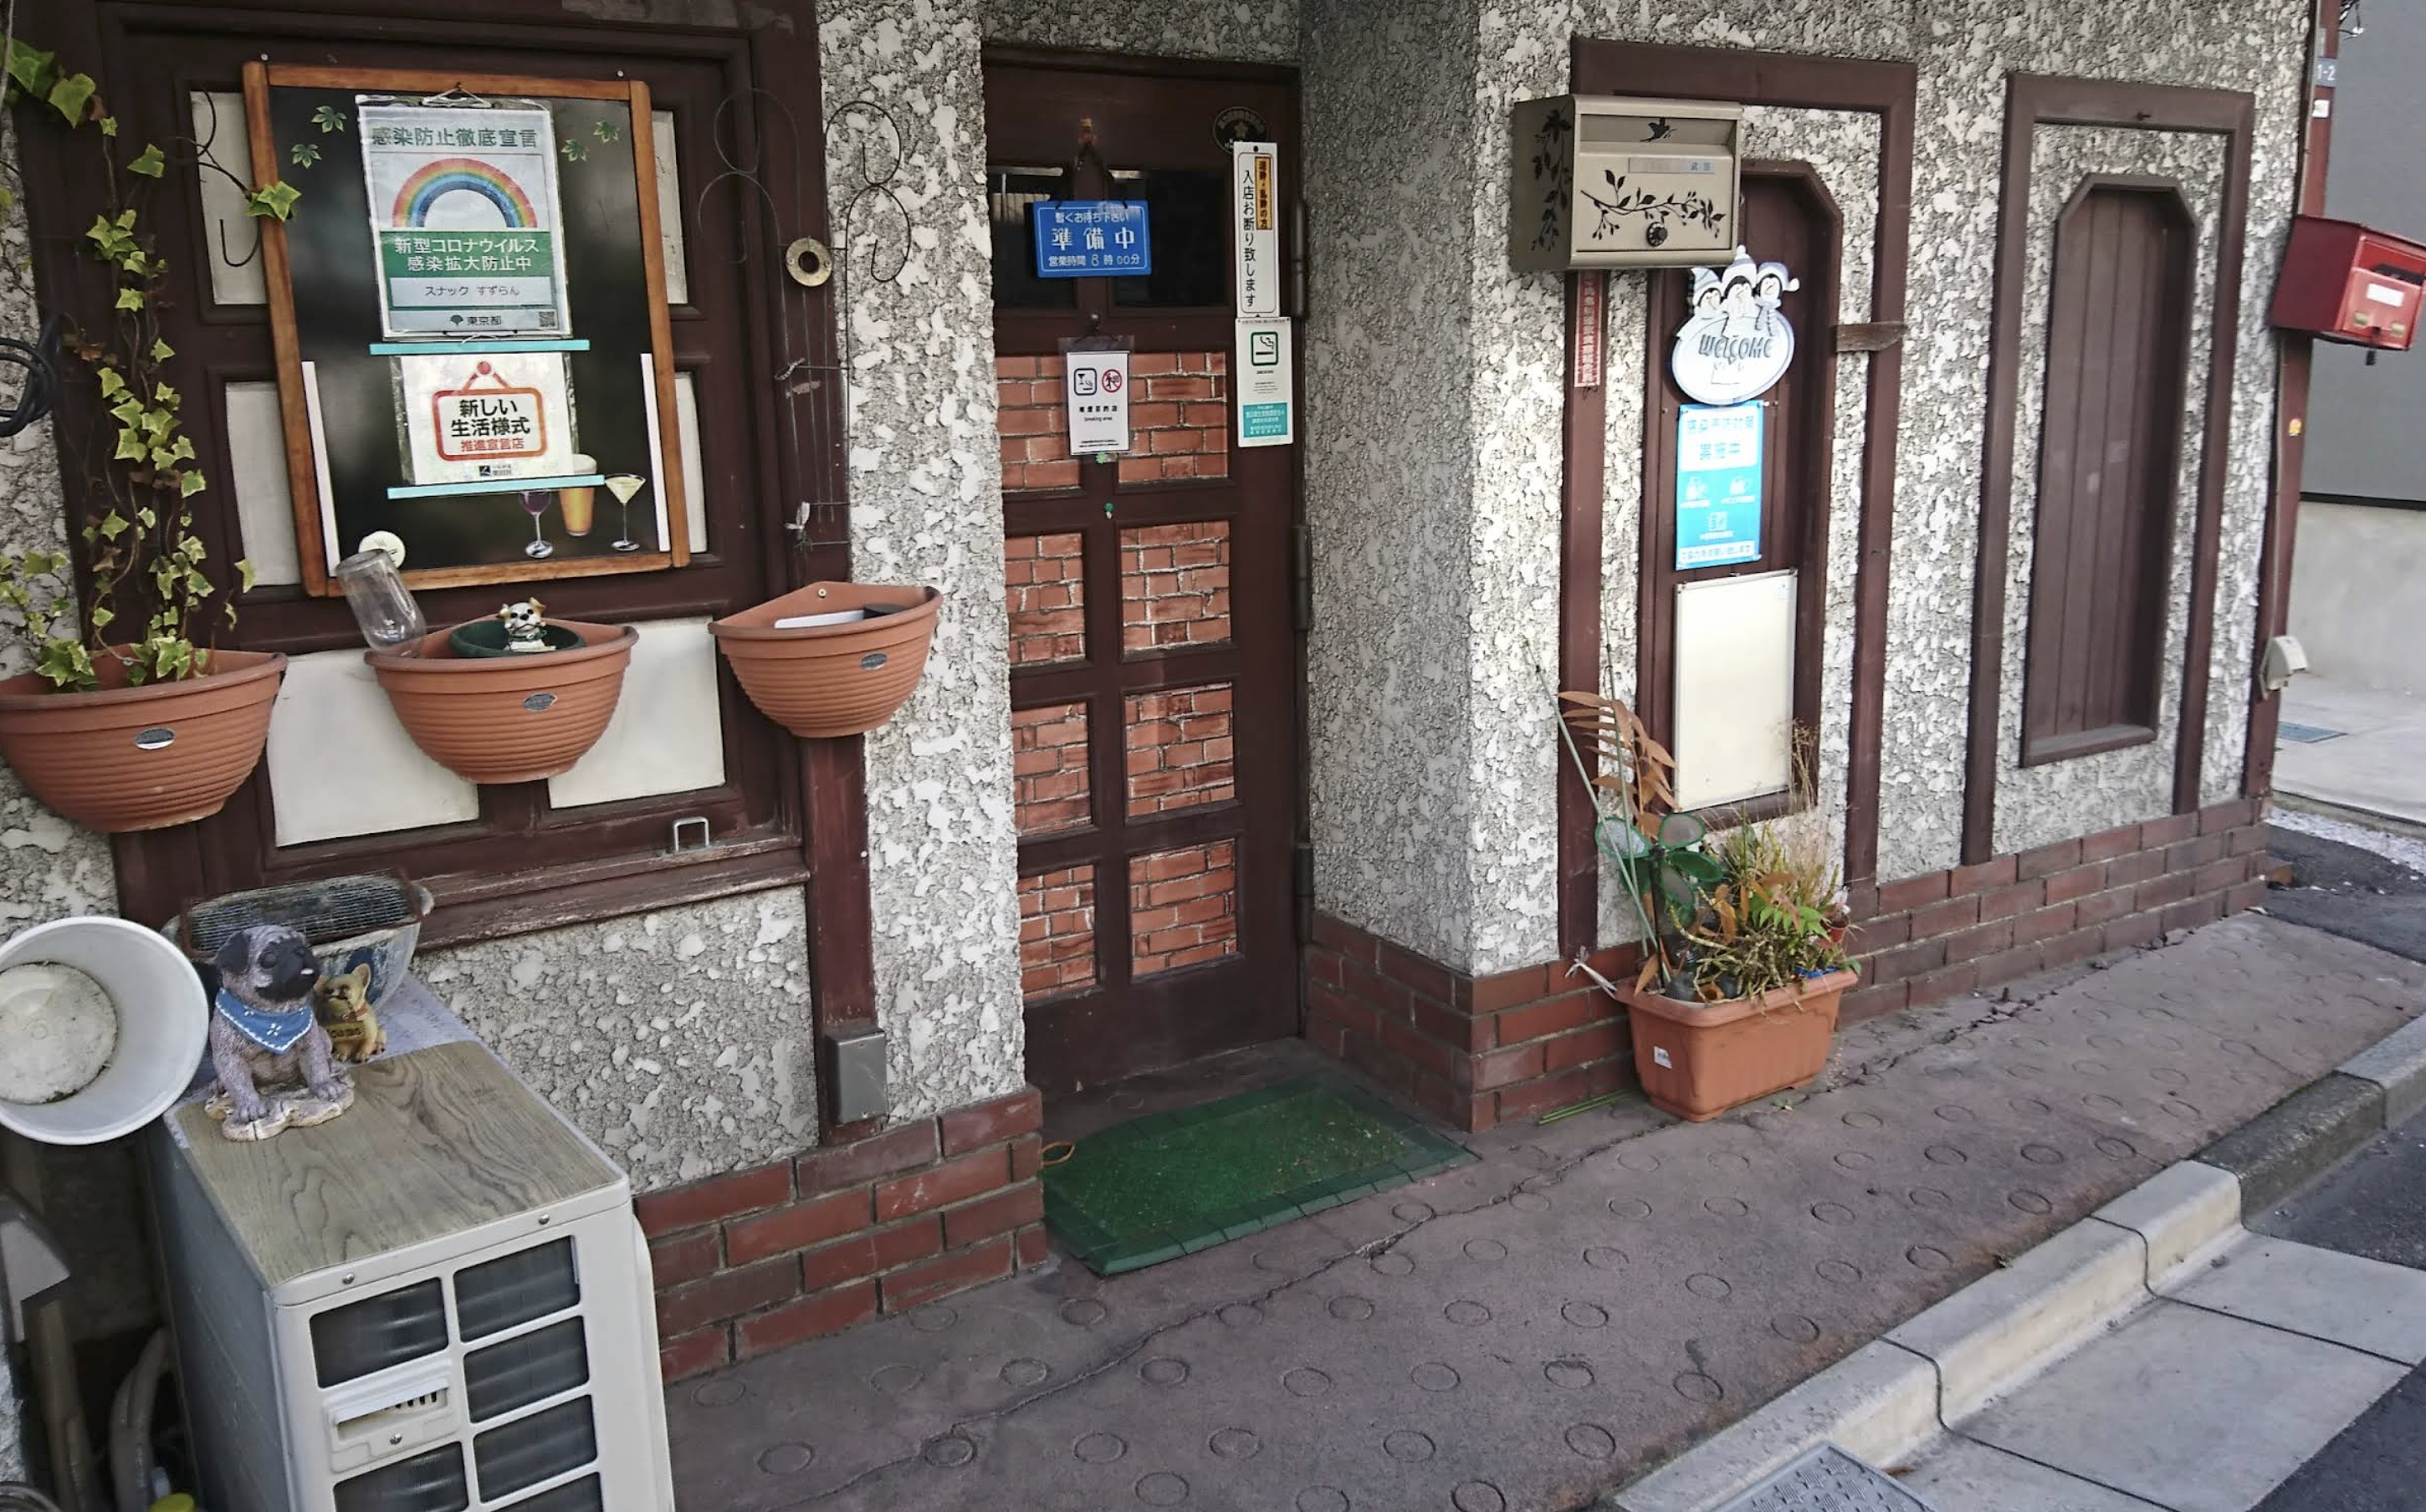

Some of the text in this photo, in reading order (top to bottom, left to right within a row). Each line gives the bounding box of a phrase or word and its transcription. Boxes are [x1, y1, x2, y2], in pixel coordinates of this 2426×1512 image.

[2316, 64, 2336, 81] 1-2
[371, 127, 537, 148] 感染防止徹底宣言
[1055, 211, 1129, 224] 暫くお待ち下さい
[394, 238, 540, 255] 新型コロナウイルス
[1051, 227, 1135, 251] 準備中
[1242, 170, 1257, 307] 入店お断り致します
[407, 256, 532, 273] 感染拡大防止中
[425, 284, 520, 296] スナック すずらん
[467, 314, 503, 326] 東京都
[459, 398, 518, 418] 新しい
[450, 416, 531, 437] 生活様式
[460, 437, 525, 452] 推進宣言店
